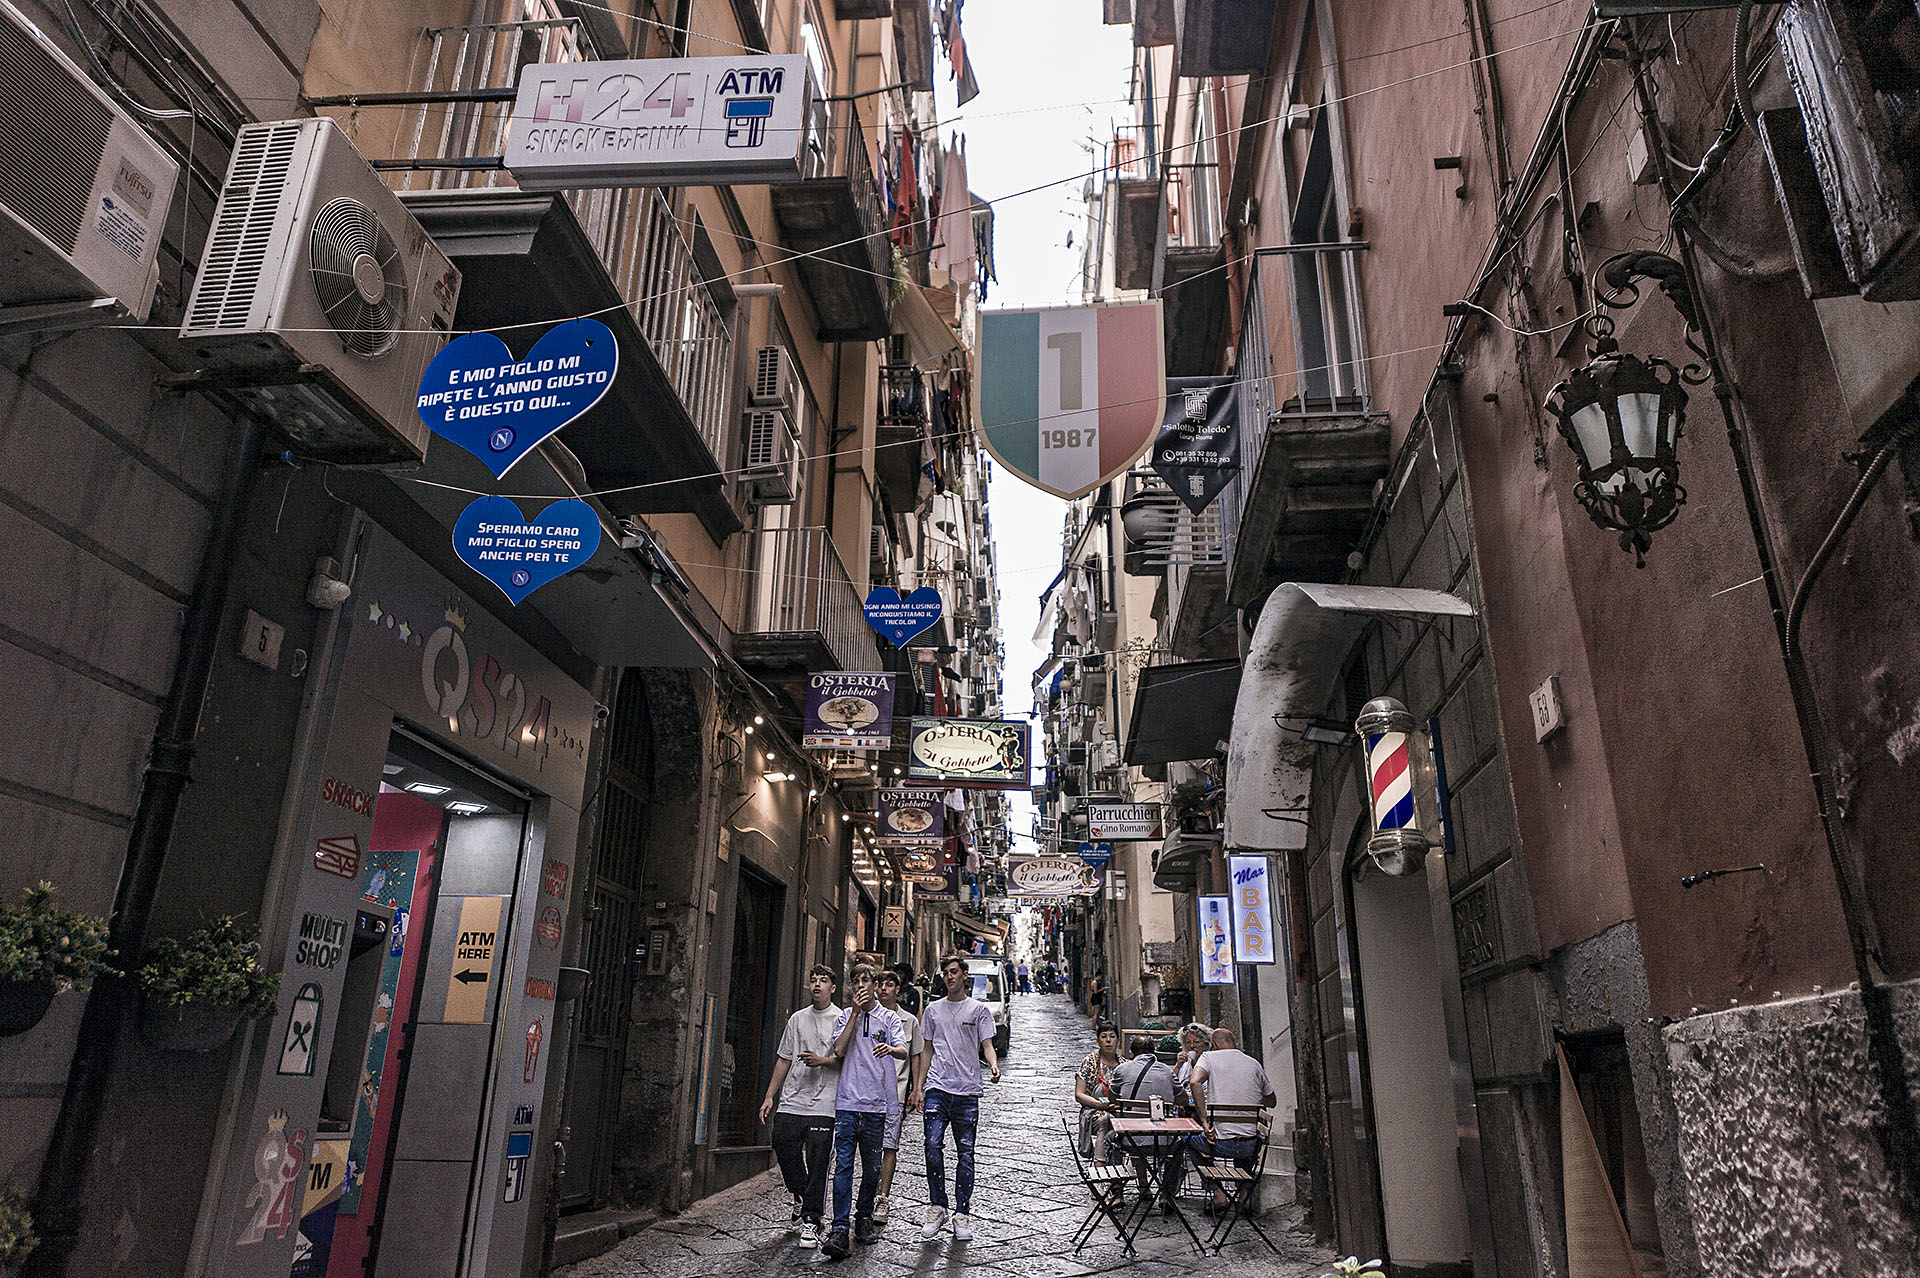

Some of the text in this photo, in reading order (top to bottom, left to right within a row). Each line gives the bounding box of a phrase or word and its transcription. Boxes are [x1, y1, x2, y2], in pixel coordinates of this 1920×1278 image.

[718, 71, 784, 97] ATM
[119, 166, 153, 201] FUJITSU
[448, 355, 581, 385] E MIO FIGLIO MI
[1047, 331, 1083, 411] 1
[416, 370, 608, 408] RIPETE L'ANNO GIUSTO
[444, 394, 572, 422] È QUESTO QUI...
[1042, 428, 1097, 449] 1987
[478, 522, 580, 537] SPERIAMO CARO
[468, 537, 581, 550] MIO FIGLIO SPERO
[479, 551, 570, 563] ANCHE PER TE
[258, 624, 270, 653] 5
[810, 674, 890, 692] OSTERIA
[821, 686, 878, 697] il Gobbetto
[1536, 693, 1550, 728] 53
[940, 753, 994, 768] Gobbetto
[322, 778, 372, 818] SNACK
[881, 791, 941, 803] OSTERIA
[1090, 806, 1160, 821] Parrucchieri
[1100, 823, 1151, 833] Gino Romano
[1020, 860, 1076, 874] OSTERIA
[1233, 867, 1266, 885] Max
[1030, 872, 1075, 882] Gobbetto
[300, 912, 346, 946] MULTI
[1240, 887, 1266, 956] BAR
[458, 931, 496, 946] ATM
[295, 940, 341, 970] SHOP
[457, 948, 491, 959] HERE
[513, 1104, 535, 1126] ATM
